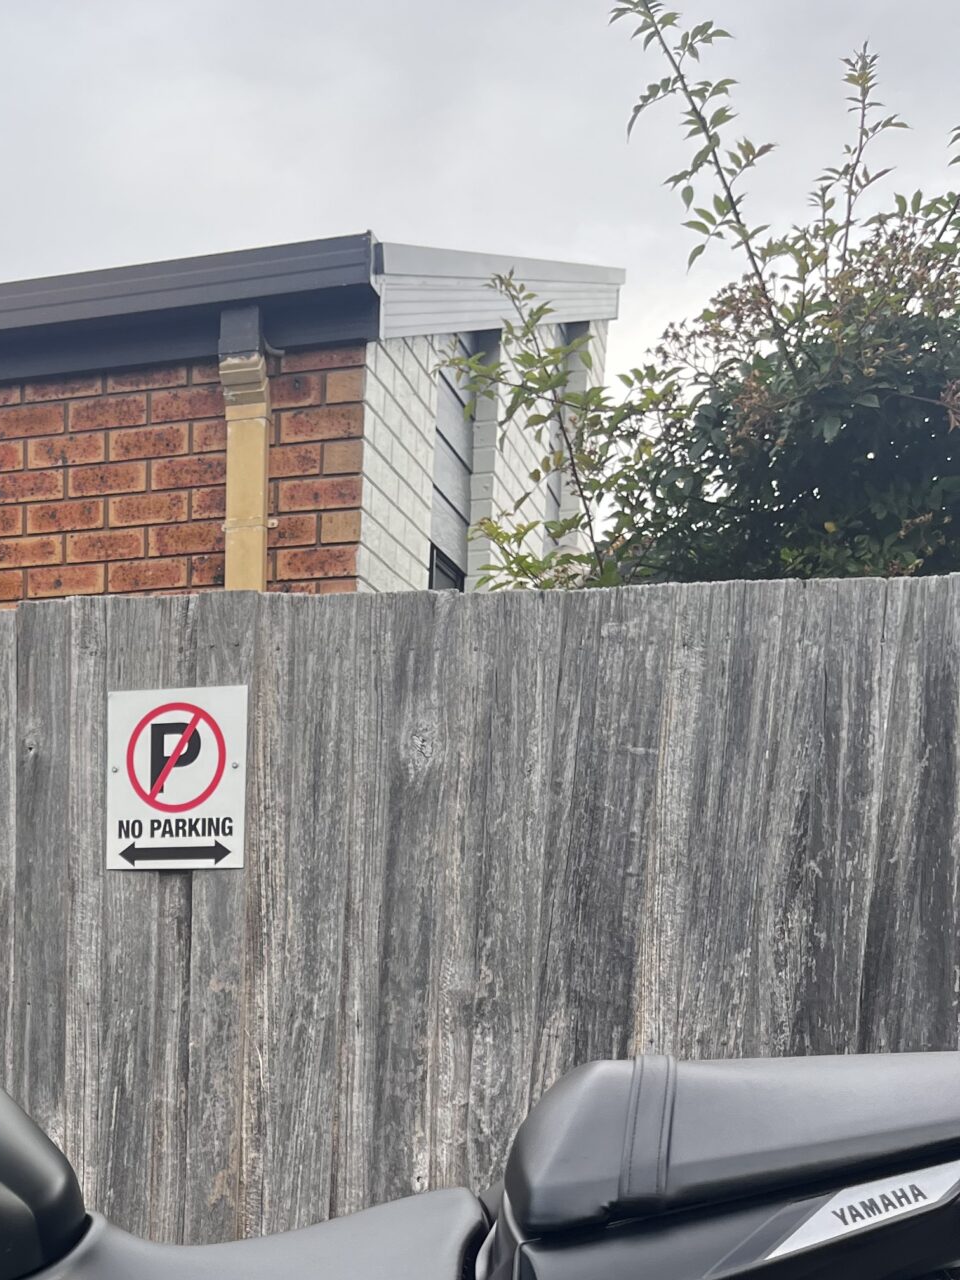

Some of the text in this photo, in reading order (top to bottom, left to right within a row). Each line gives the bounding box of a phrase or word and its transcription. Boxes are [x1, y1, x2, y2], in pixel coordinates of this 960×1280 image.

[150, 722, 201, 793] P
[118, 816, 233, 839] NO PARKING
[831, 1184, 928, 1226] YAMAHA
